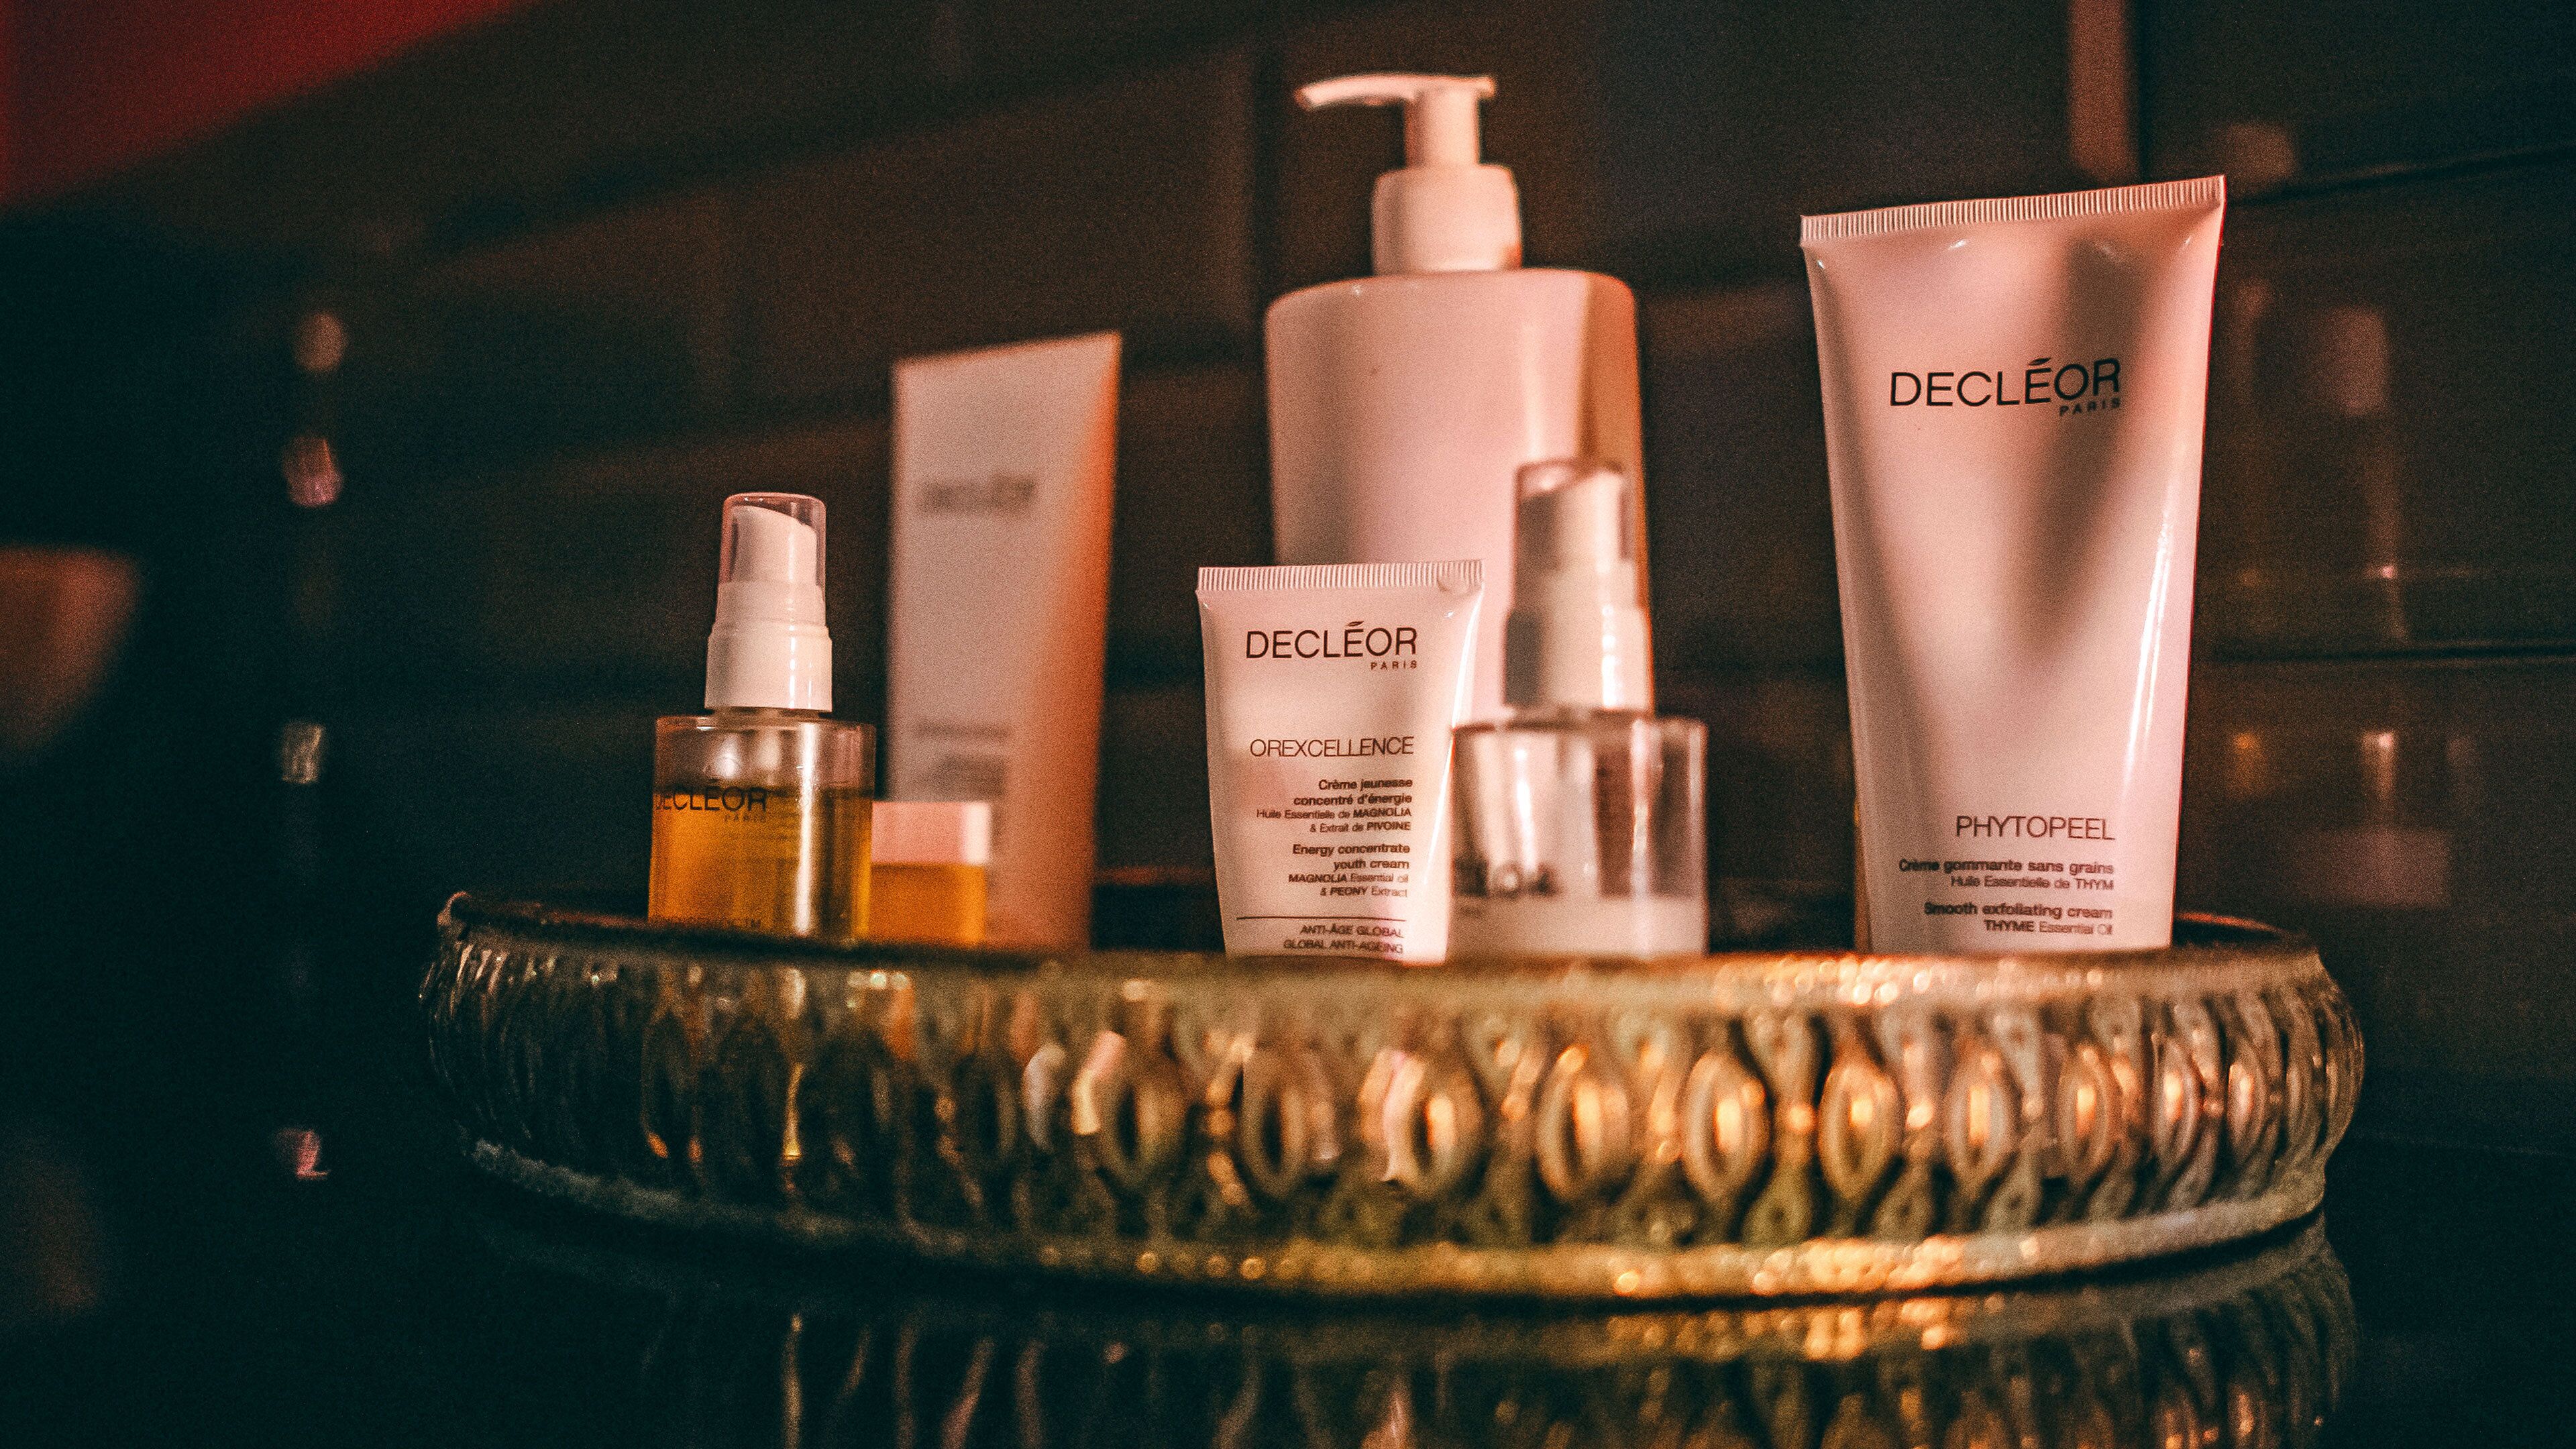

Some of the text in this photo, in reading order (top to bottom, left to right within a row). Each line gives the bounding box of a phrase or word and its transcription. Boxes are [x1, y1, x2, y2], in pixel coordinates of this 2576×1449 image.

[1889, 357, 2121, 407] DECLÉOR
[2059, 397, 2121, 417] PARIS
[1246, 620, 1417, 659] DECLÉOR
[1371, 659, 1417, 671] PARIS
[1250, 737, 1414, 757] OREXCELLENCE
[1318, 778, 1413, 792] Crème jeunesse
[1293, 793, 1413, 806] concentré d'énergie
[1256, 807, 1412, 819] Huile Essentielle de MAGNOLIA
[1309, 821, 1411, 833] & Extrait de PIVOINE
[1955, 814, 2116, 841] PHYTOPEEL
[1292, 843, 1410, 857] Energy concentrate
[1334, 859, 1409, 871] youth cream
[1898, 858, 2114, 875] Crème gommante sans grains
[1289, 873, 1347, 883] MAGNOLIA
[1350, 873, 1393, 882] Essential
[1951, 875, 2114, 890] Huile Essentielle de THYM
[1320, 885, 1408, 898] & PEONY Extract
[1924, 902, 2112, 920] Smooth exfoliating cream
[1356, 925, 1404, 938] GLOBAL
[1984, 919, 2035, 932] THYME
[2039, 920, 2093, 934] Essential
[1283, 940, 1403, 954] GLOBAL ANTI-AGEING
